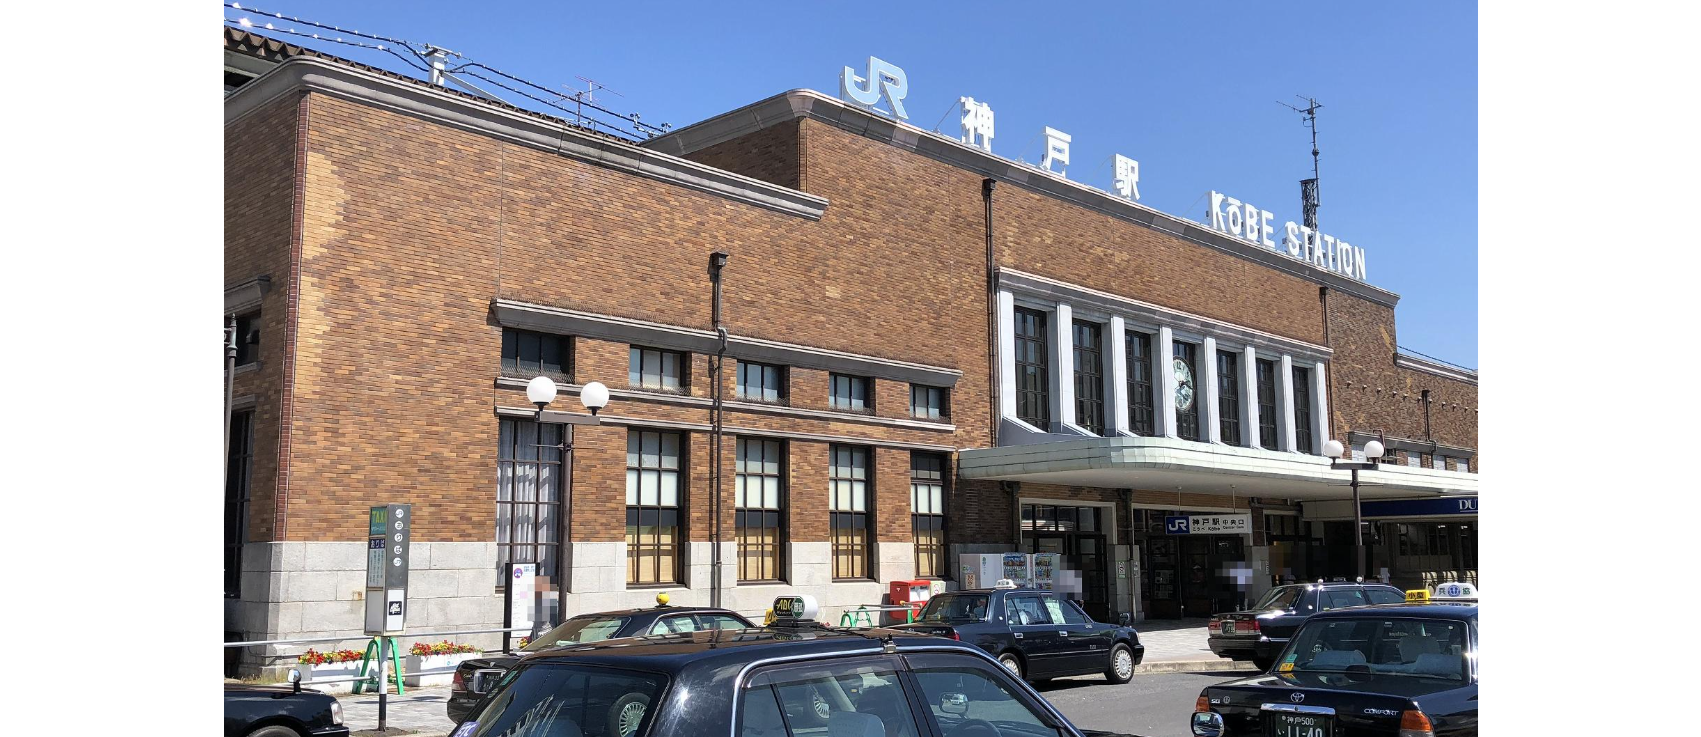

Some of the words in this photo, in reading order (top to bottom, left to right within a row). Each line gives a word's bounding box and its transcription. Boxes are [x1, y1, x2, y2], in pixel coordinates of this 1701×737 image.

[844, 56, 908, 119] JR
[1285, 221, 1366, 280] STATION
[1168, 519, 1188, 531] JR
[1192, 518, 1220, 526] 神戸駅
[1301, 717, 1314, 726] 500
